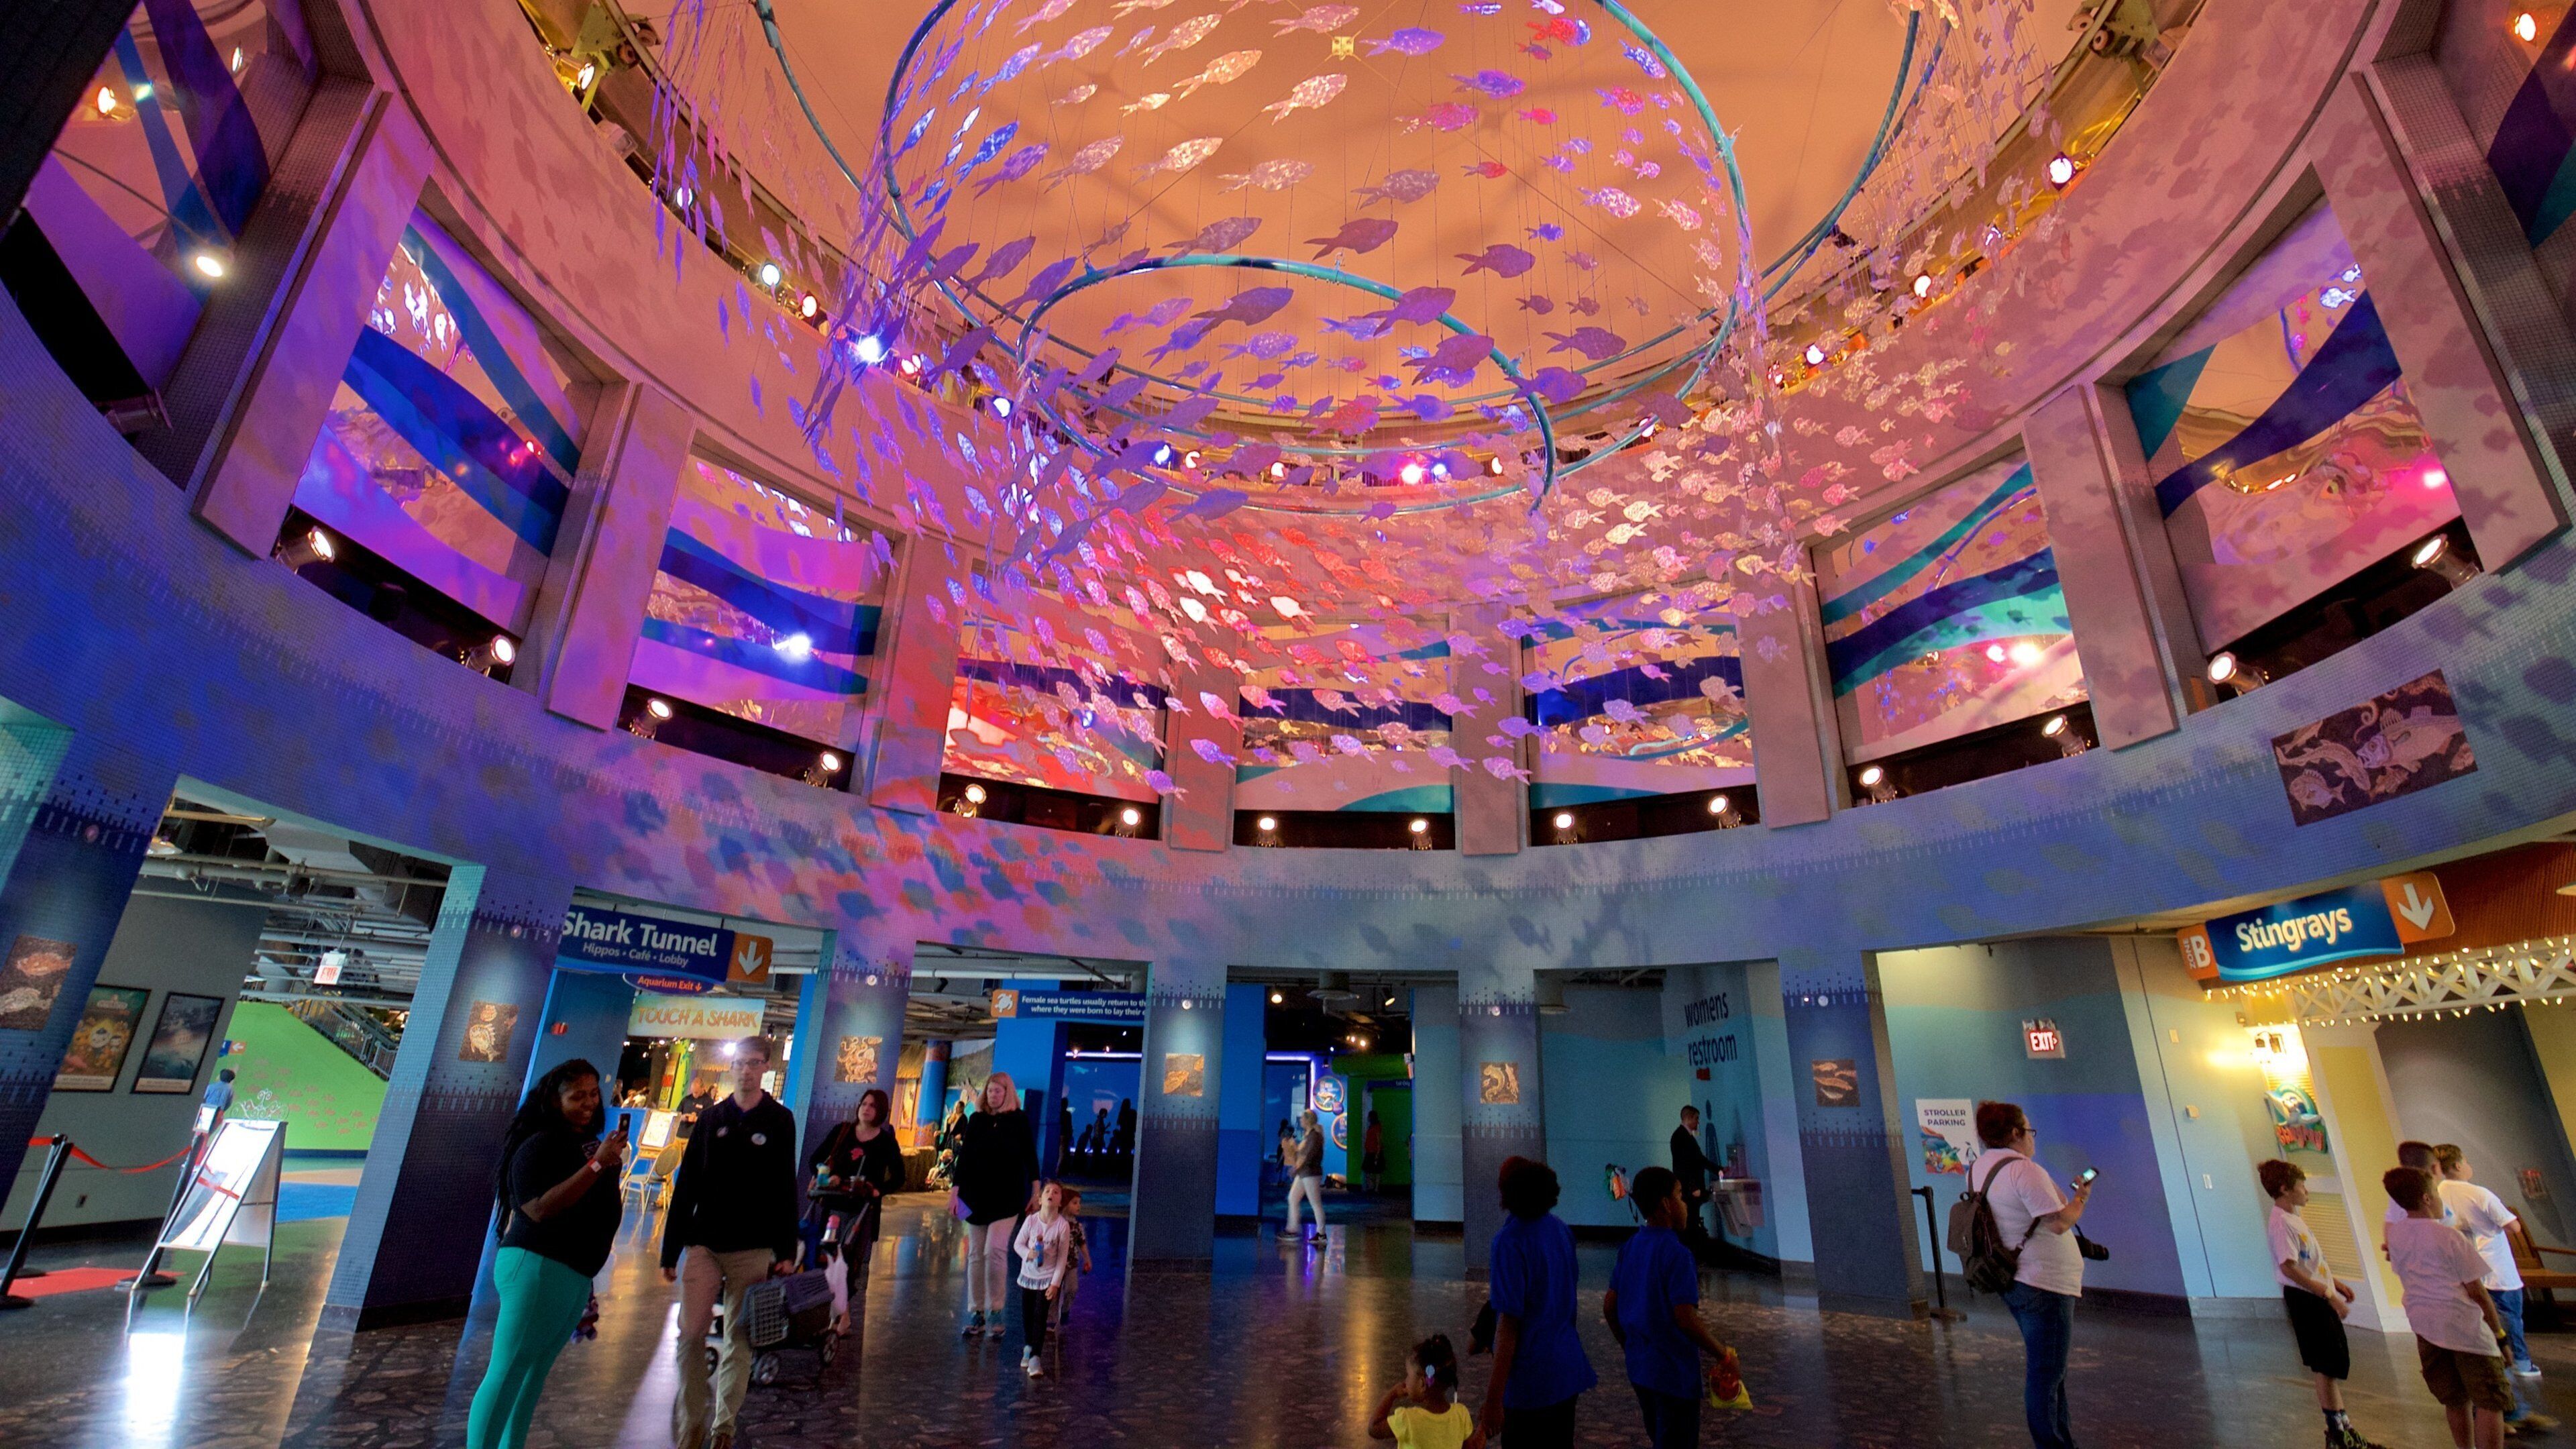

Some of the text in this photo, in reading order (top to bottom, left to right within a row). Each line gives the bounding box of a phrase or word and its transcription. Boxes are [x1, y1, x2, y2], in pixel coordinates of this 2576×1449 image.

[561, 911, 718, 957] Shark Tunnel
[2236, 908, 2353, 952] Stingrays
[583, 942, 689, 967] Hippos Café Lobby
[2182, 938, 2197, 969] ZONE
[2190, 936, 2210, 968] B
[637, 975, 694, 990] Aquarium Exit
[1022, 996, 1046, 1004] Female
[1060, 997, 1081, 1005] turtles
[1083, 998, 1106, 1007] usually
[1031, 1005, 1052, 1013] where
[1053, 1006, 1069, 1015] they
[1113, 1008, 1124, 1017] lay
[1124, 1008, 1141, 1016] their
[1684, 992, 1729, 1028] womens
[637, 1008, 759, 1027] TOUCH A SHARK
[1688, 1034, 1738, 1066] restroom
[2030, 1032, 2055, 1051] EXIT
